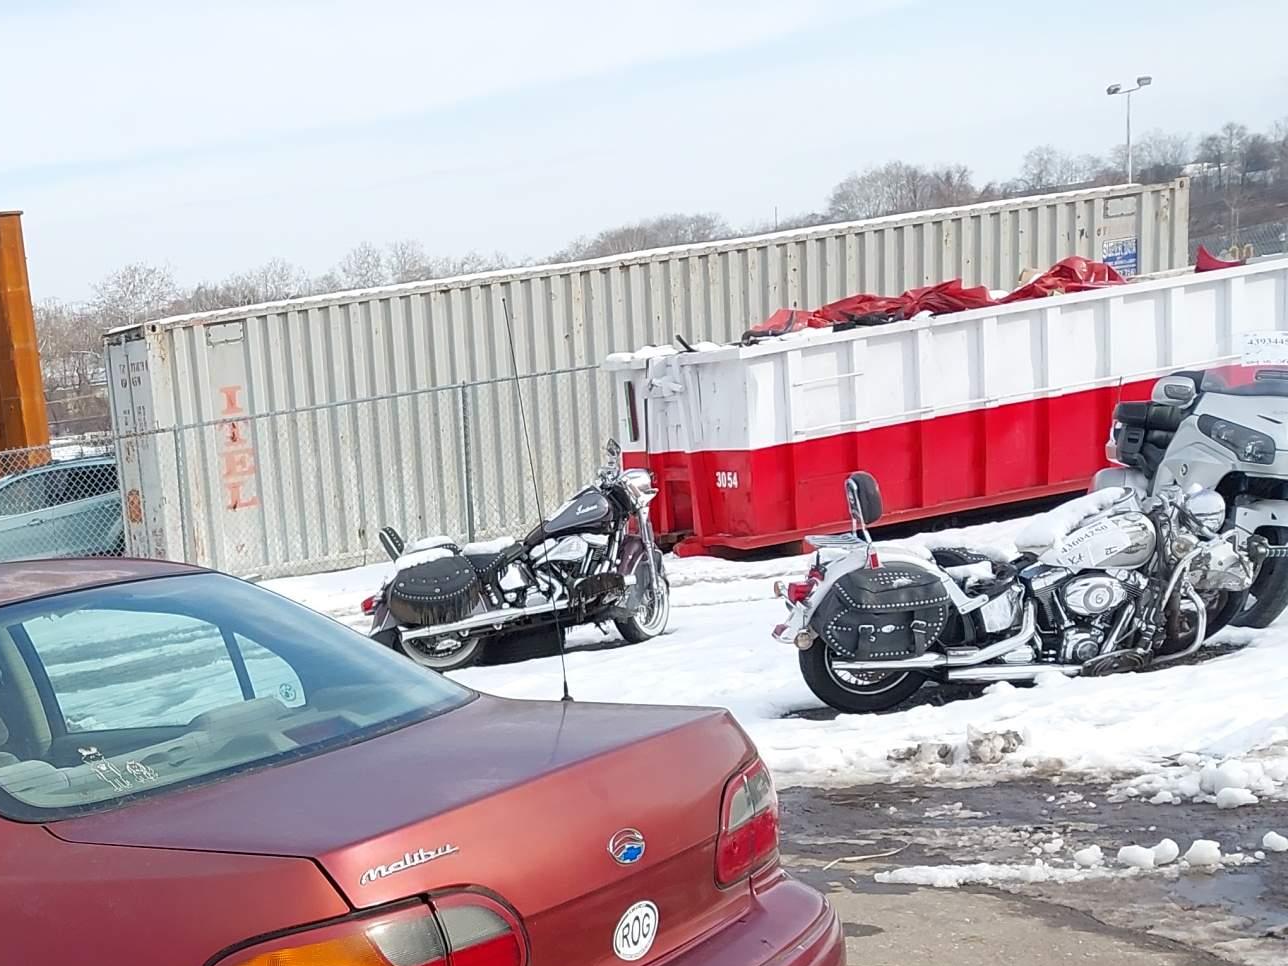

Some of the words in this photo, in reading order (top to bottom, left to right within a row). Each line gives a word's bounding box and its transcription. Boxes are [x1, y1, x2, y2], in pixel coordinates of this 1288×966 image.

[715, 471, 739, 489] 3054
[359, 843, 460, 886] Malibu
[621, 912, 651, 949] ROG
